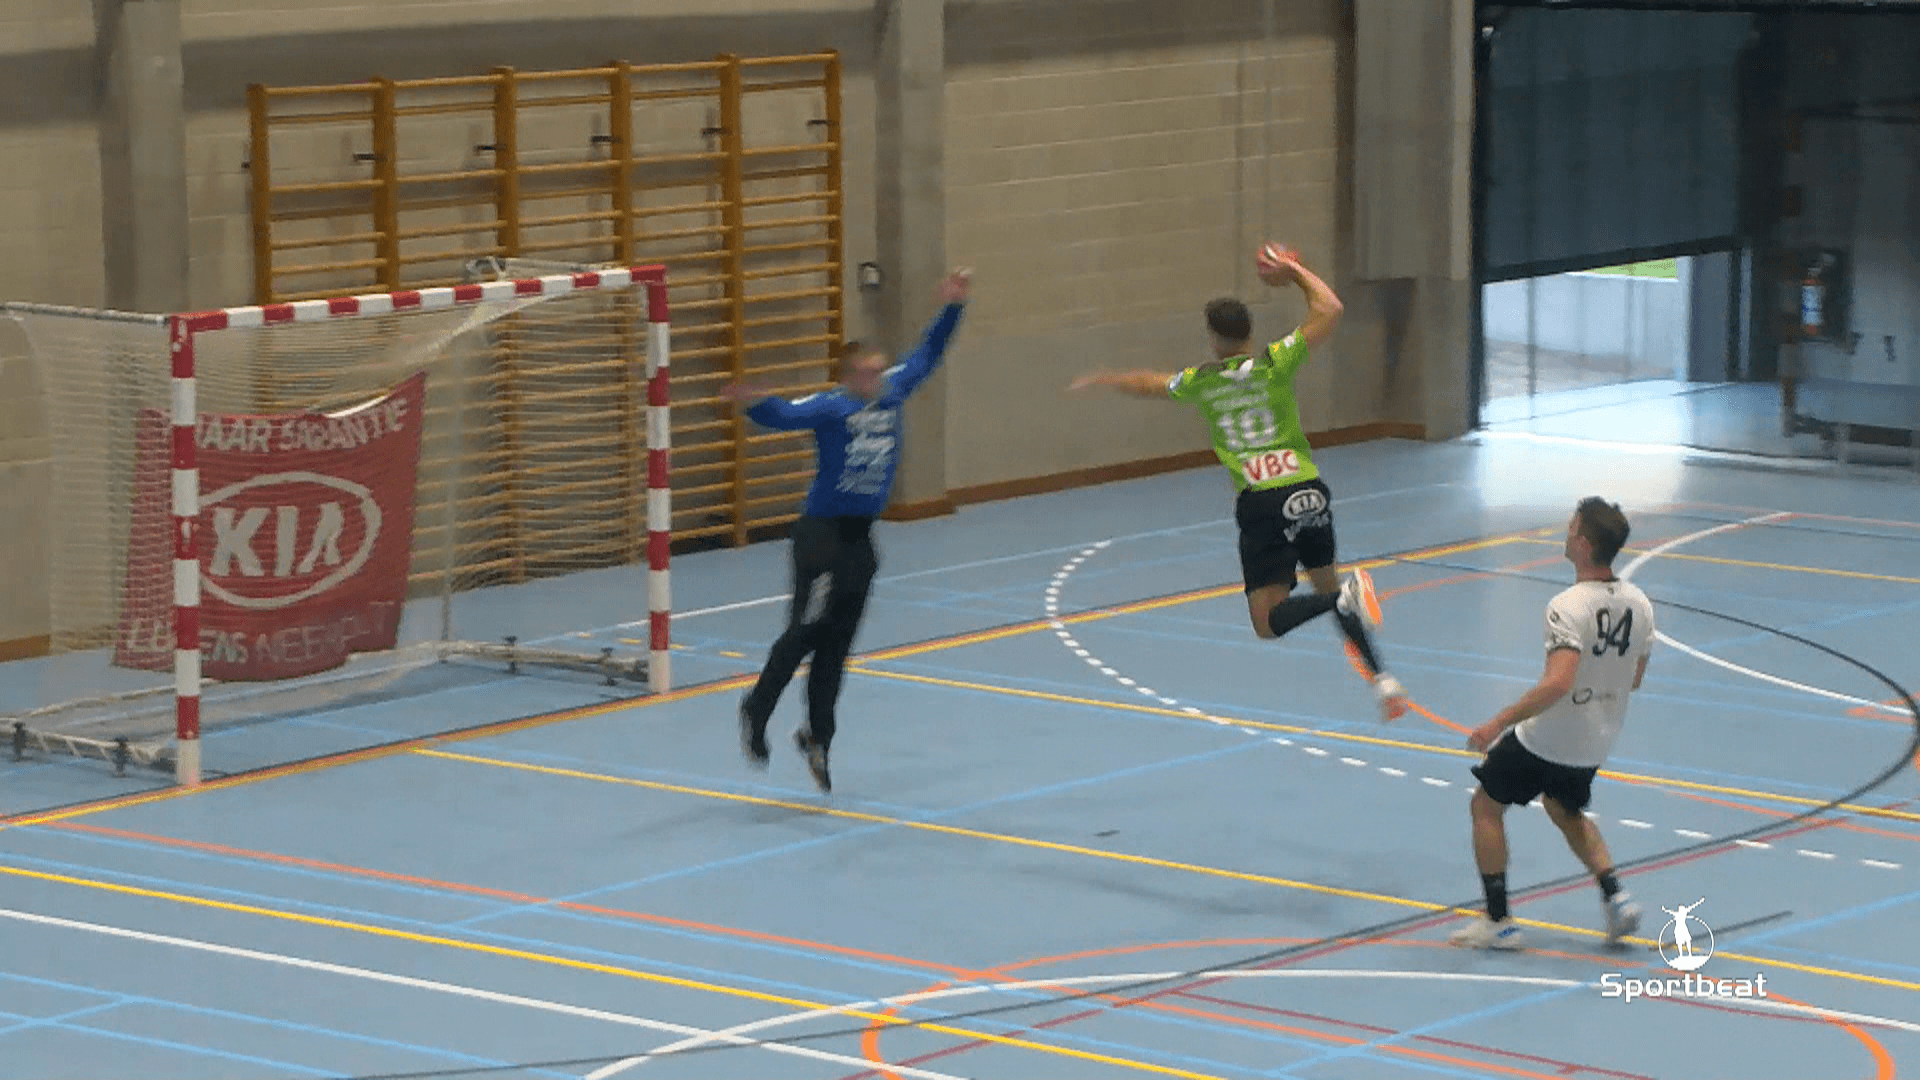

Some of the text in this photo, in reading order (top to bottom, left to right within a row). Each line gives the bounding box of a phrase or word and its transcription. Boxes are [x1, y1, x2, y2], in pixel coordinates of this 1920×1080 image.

[1217, 407, 1277, 451] 10
[1244, 449, 1300, 482] VBC
[209, 501, 345, 578] KIA
[1592, 607, 1633, 657] 94
